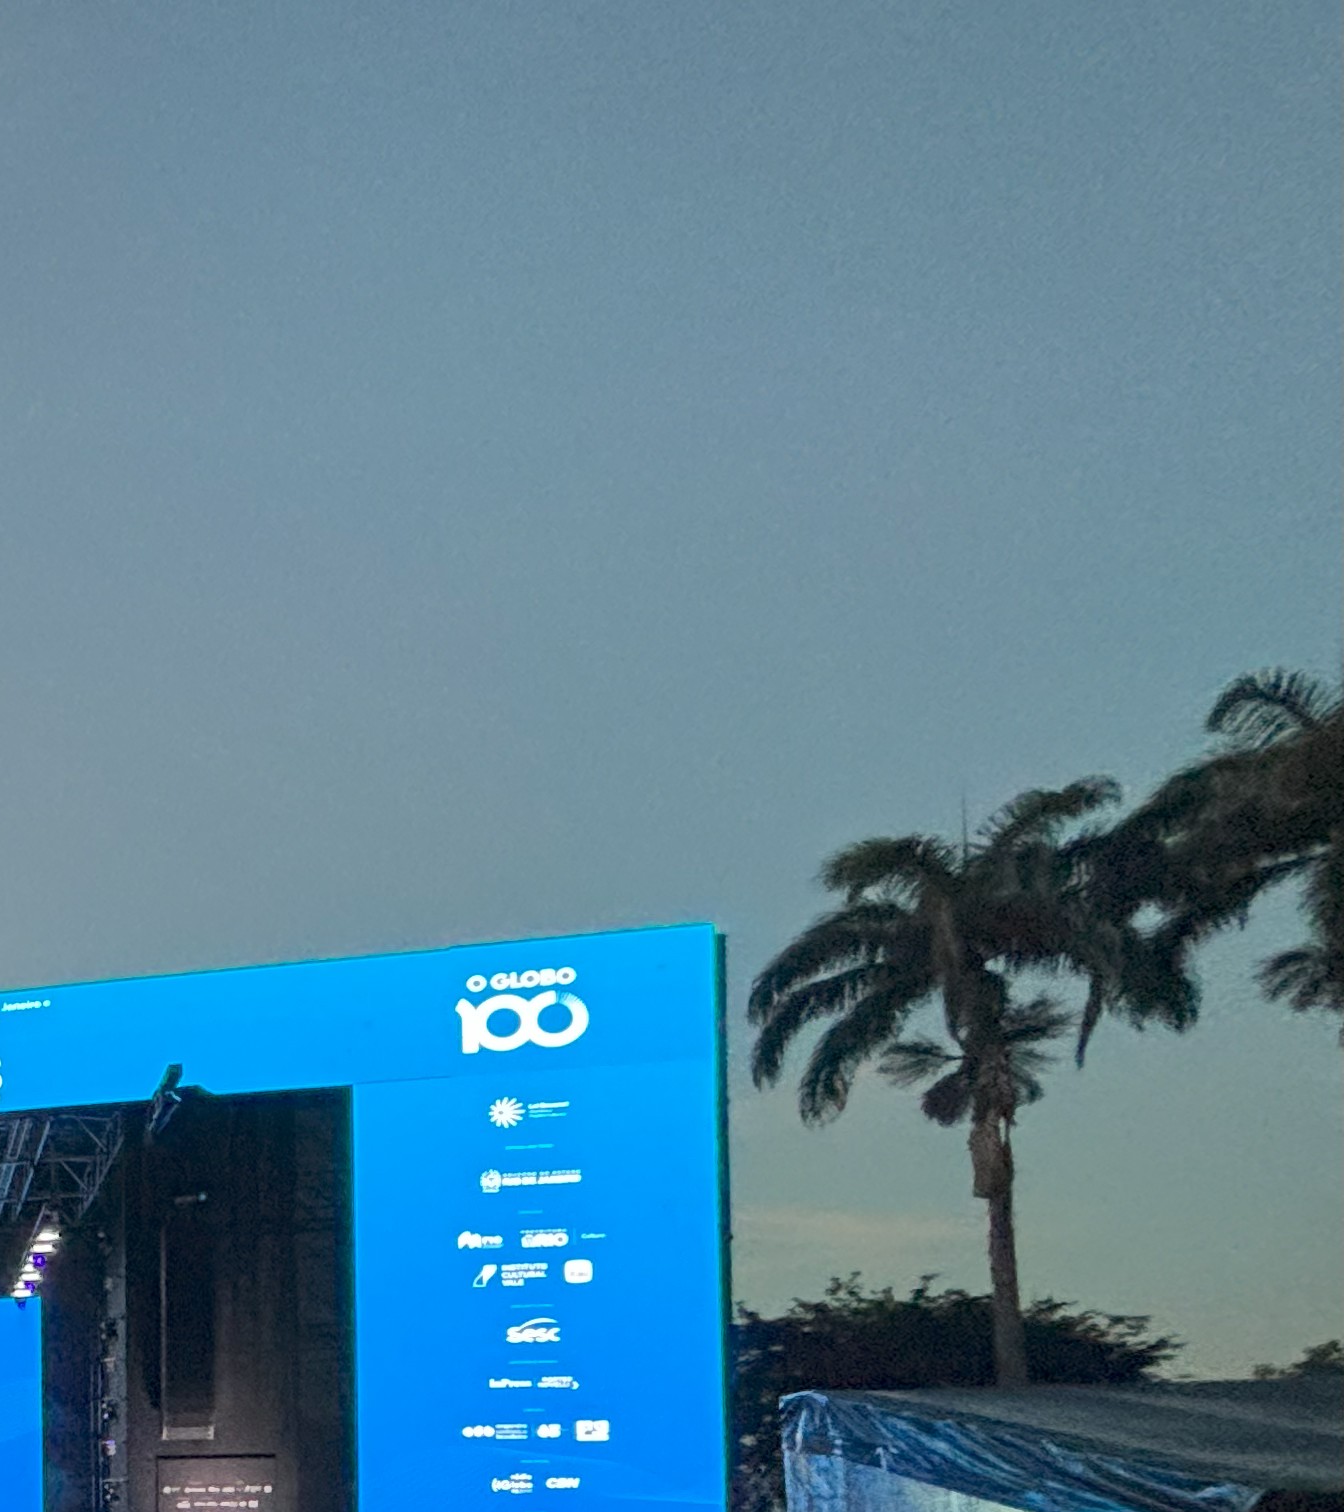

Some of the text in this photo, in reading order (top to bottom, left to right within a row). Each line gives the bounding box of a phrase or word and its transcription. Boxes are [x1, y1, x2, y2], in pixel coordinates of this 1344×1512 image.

[466, 966, 578, 993] O GLOBO
[455, 990, 590, 1054] 100
